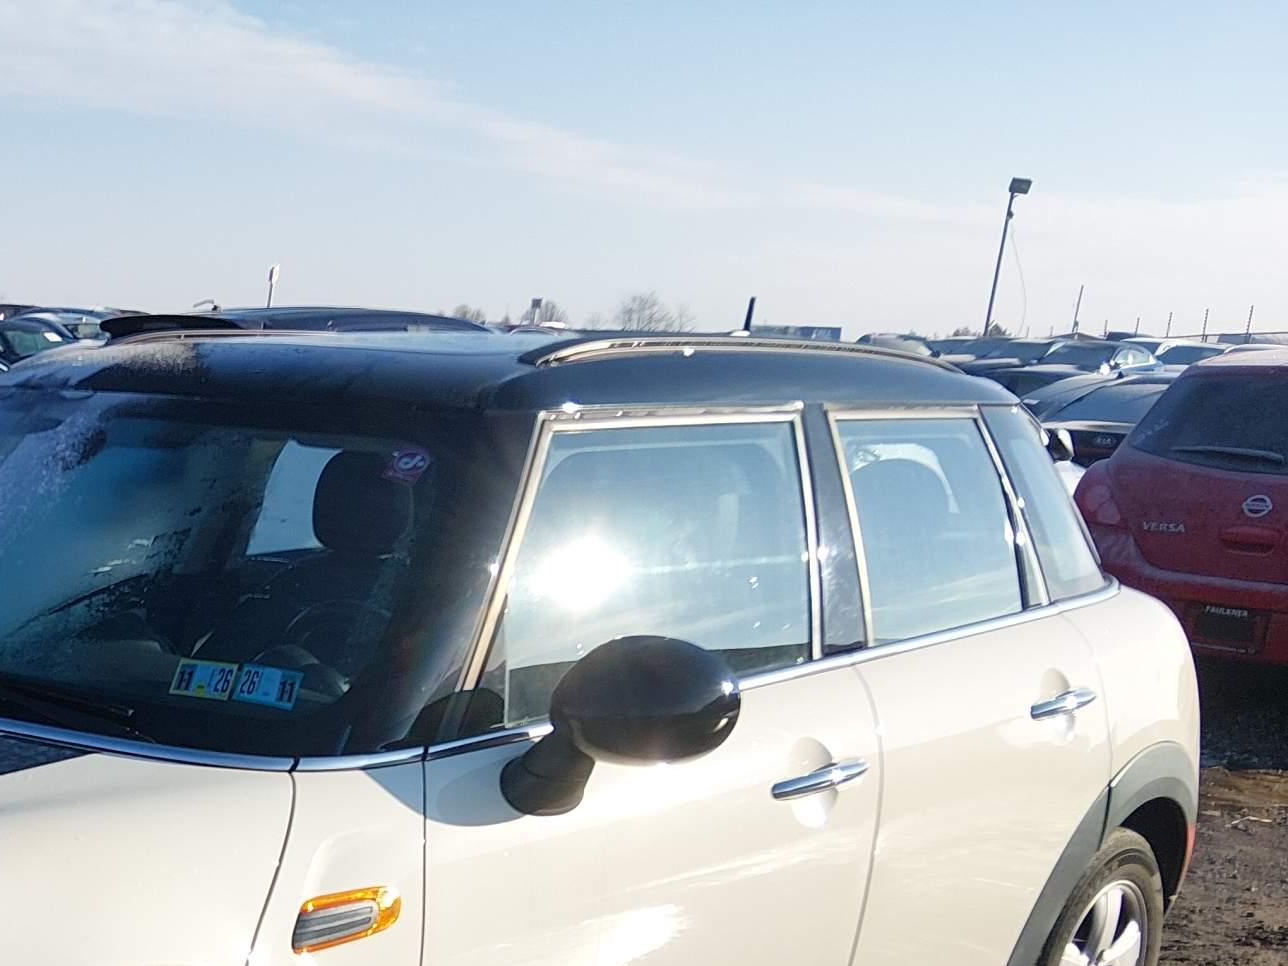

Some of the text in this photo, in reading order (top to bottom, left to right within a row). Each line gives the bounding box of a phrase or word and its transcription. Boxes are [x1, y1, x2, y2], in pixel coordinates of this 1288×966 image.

[1143, 520, 1185, 533] VERSA
[177, 668, 233, 694] 11 26
[239, 669, 296, 703] 26 11
